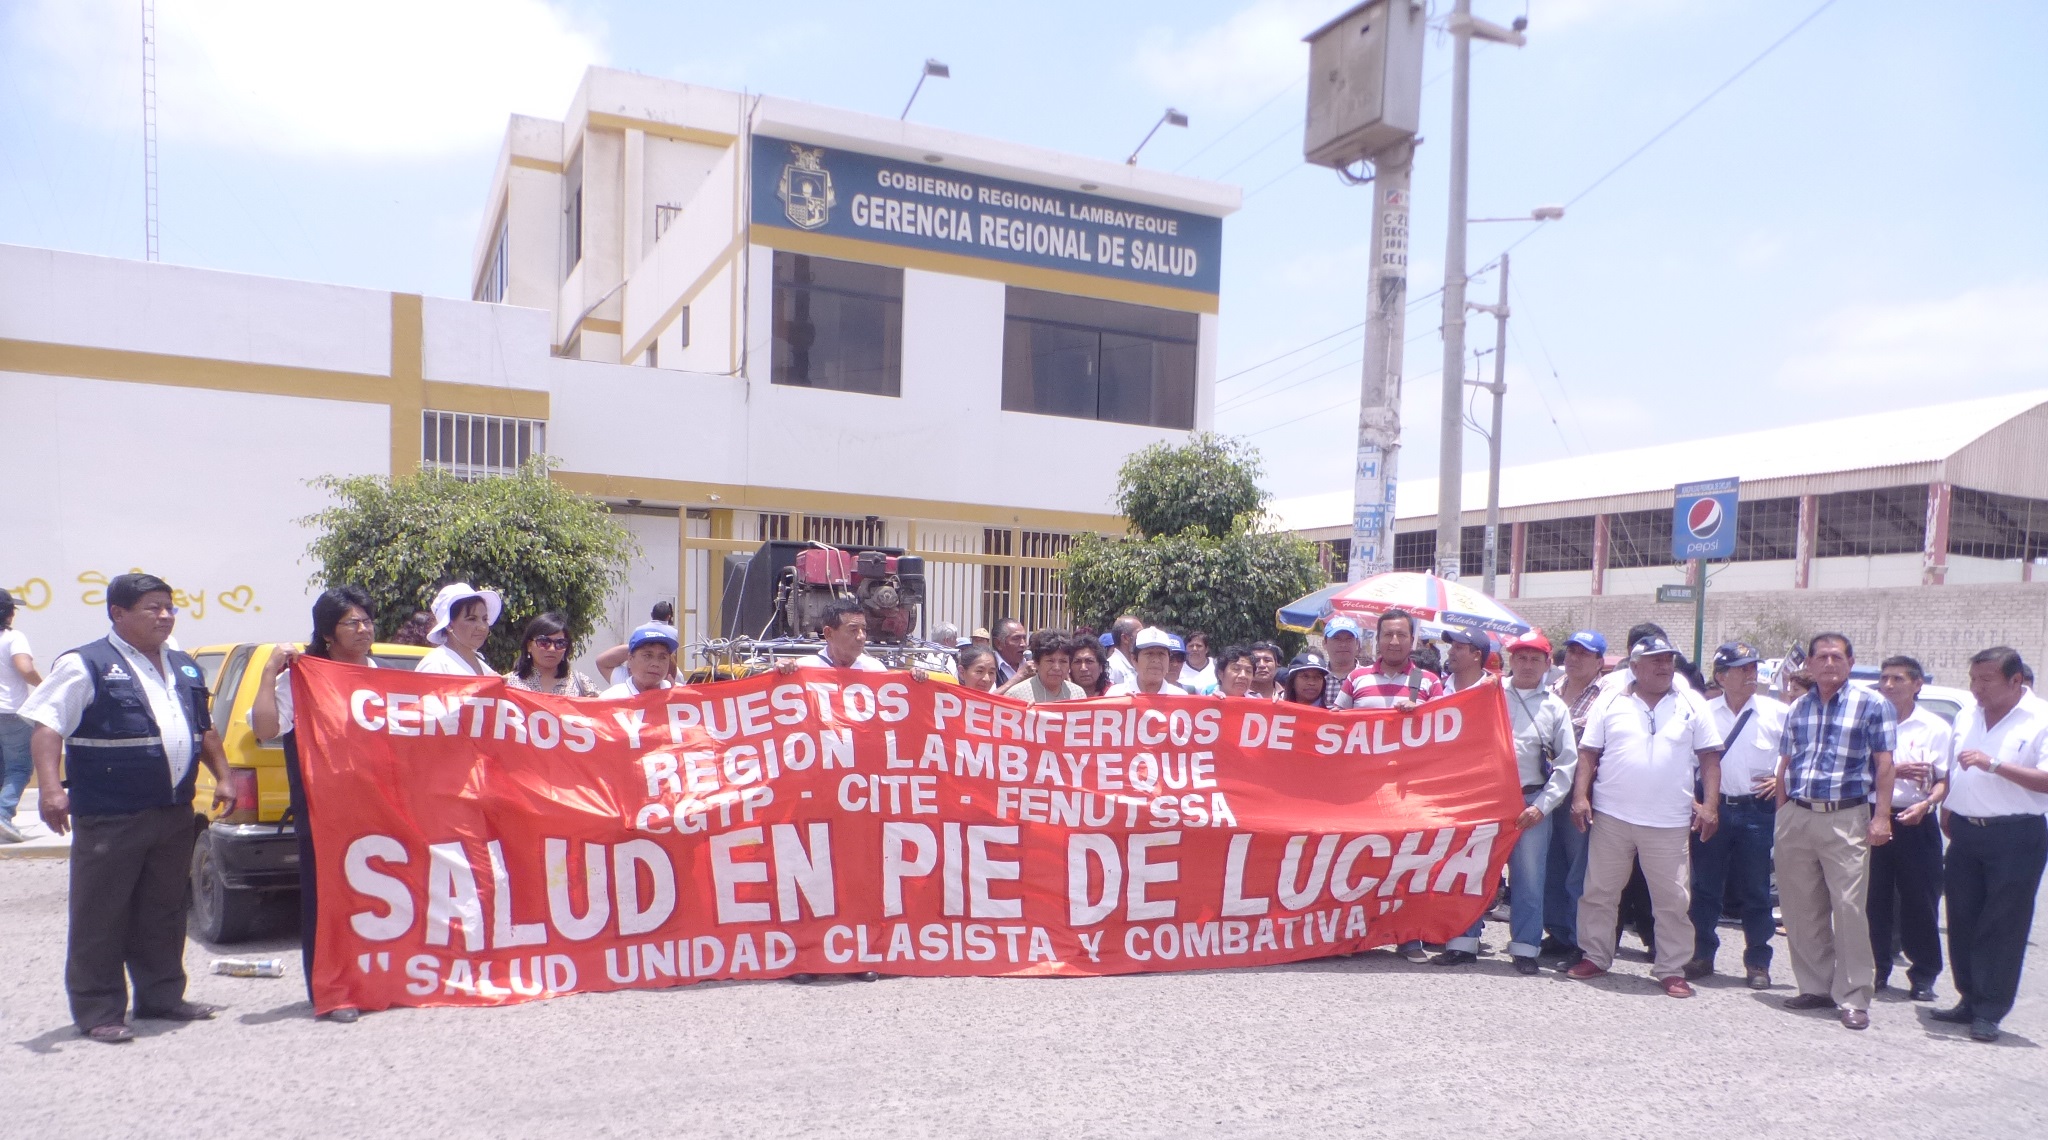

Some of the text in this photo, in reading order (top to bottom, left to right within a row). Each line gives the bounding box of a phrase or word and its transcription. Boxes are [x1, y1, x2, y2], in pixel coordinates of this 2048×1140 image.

[878, 169, 1178, 236] GOBIERNO REGIONAL LAMBAYEQUE
[851, 194, 1197, 278] GERENCIA REGIONAL DE SALUD
[1687, 539, 1719, 554] pepsi
[1340, 601, 1379, 610] Helados
[1446, 613, 1518, 634] Helados Aruba
[351, 682, 1463, 755] CENTROS Y PUESTOS PERIFERICOS DE SALUD
[643, 728, 1217, 797] REGION LAMBAYEQUE
[636, 787, 774, 834] CGTP
[837, 774, 938, 814] CITE
[996, 787, 1238, 829] FENUTSSA
[343, 822, 1499, 952] SALUD EN PIE DE LUCHA
[605, 931, 797, 983] UNIDAD
[824, 922, 1057, 964] CLASISTA
[1078, 930, 1104, 963] Y
